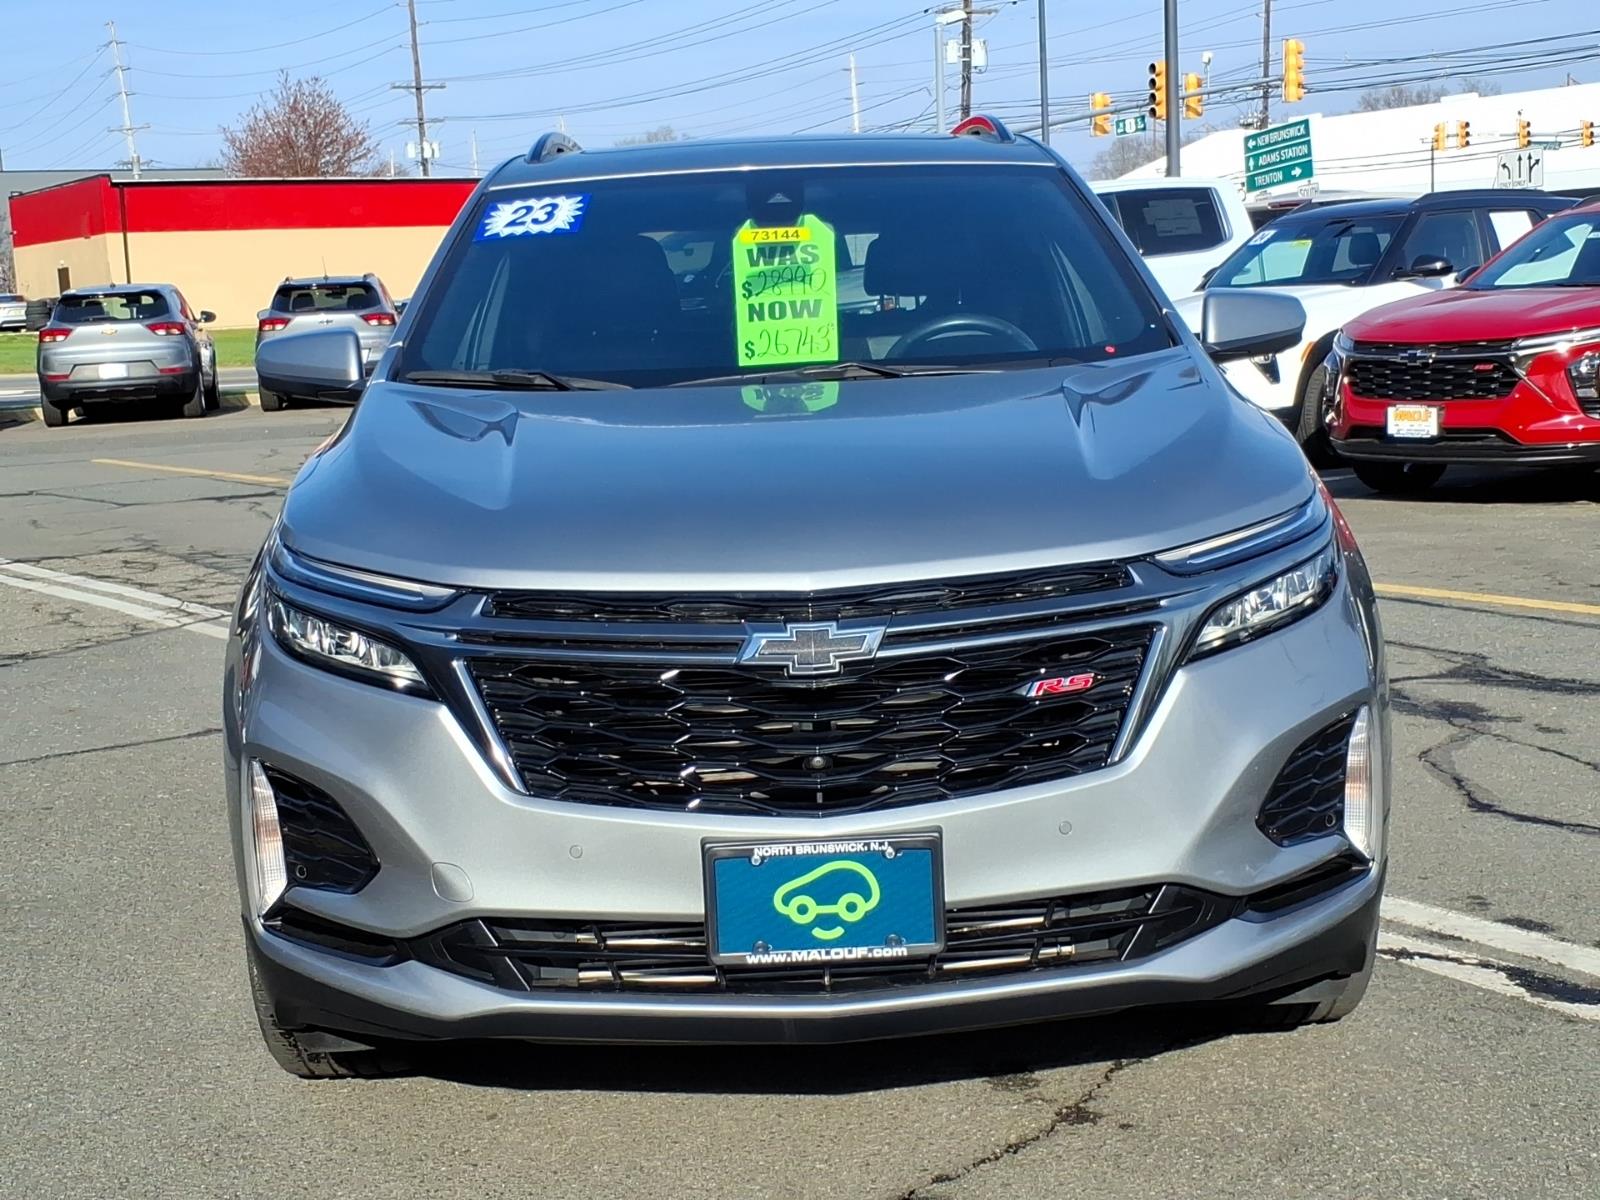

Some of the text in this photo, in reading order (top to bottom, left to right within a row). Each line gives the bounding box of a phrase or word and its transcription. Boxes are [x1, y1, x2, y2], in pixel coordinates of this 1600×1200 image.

[1257, 124, 1306, 147] NEW BRUNSWICK
[1258, 144, 1309, 167] ADAMS STATION
[1254, 171, 1283, 188] TRENTON
[503, 203, 560, 228] 23
[751, 229, 801, 241] 73144
[746, 243, 820, 269] WAS
[747, 298, 823, 323] NOW
[1034, 672, 1095, 697] RS
[753, 846, 793, 857] NORTH
[745, 946, 908, 965] www.MALOUF.com
